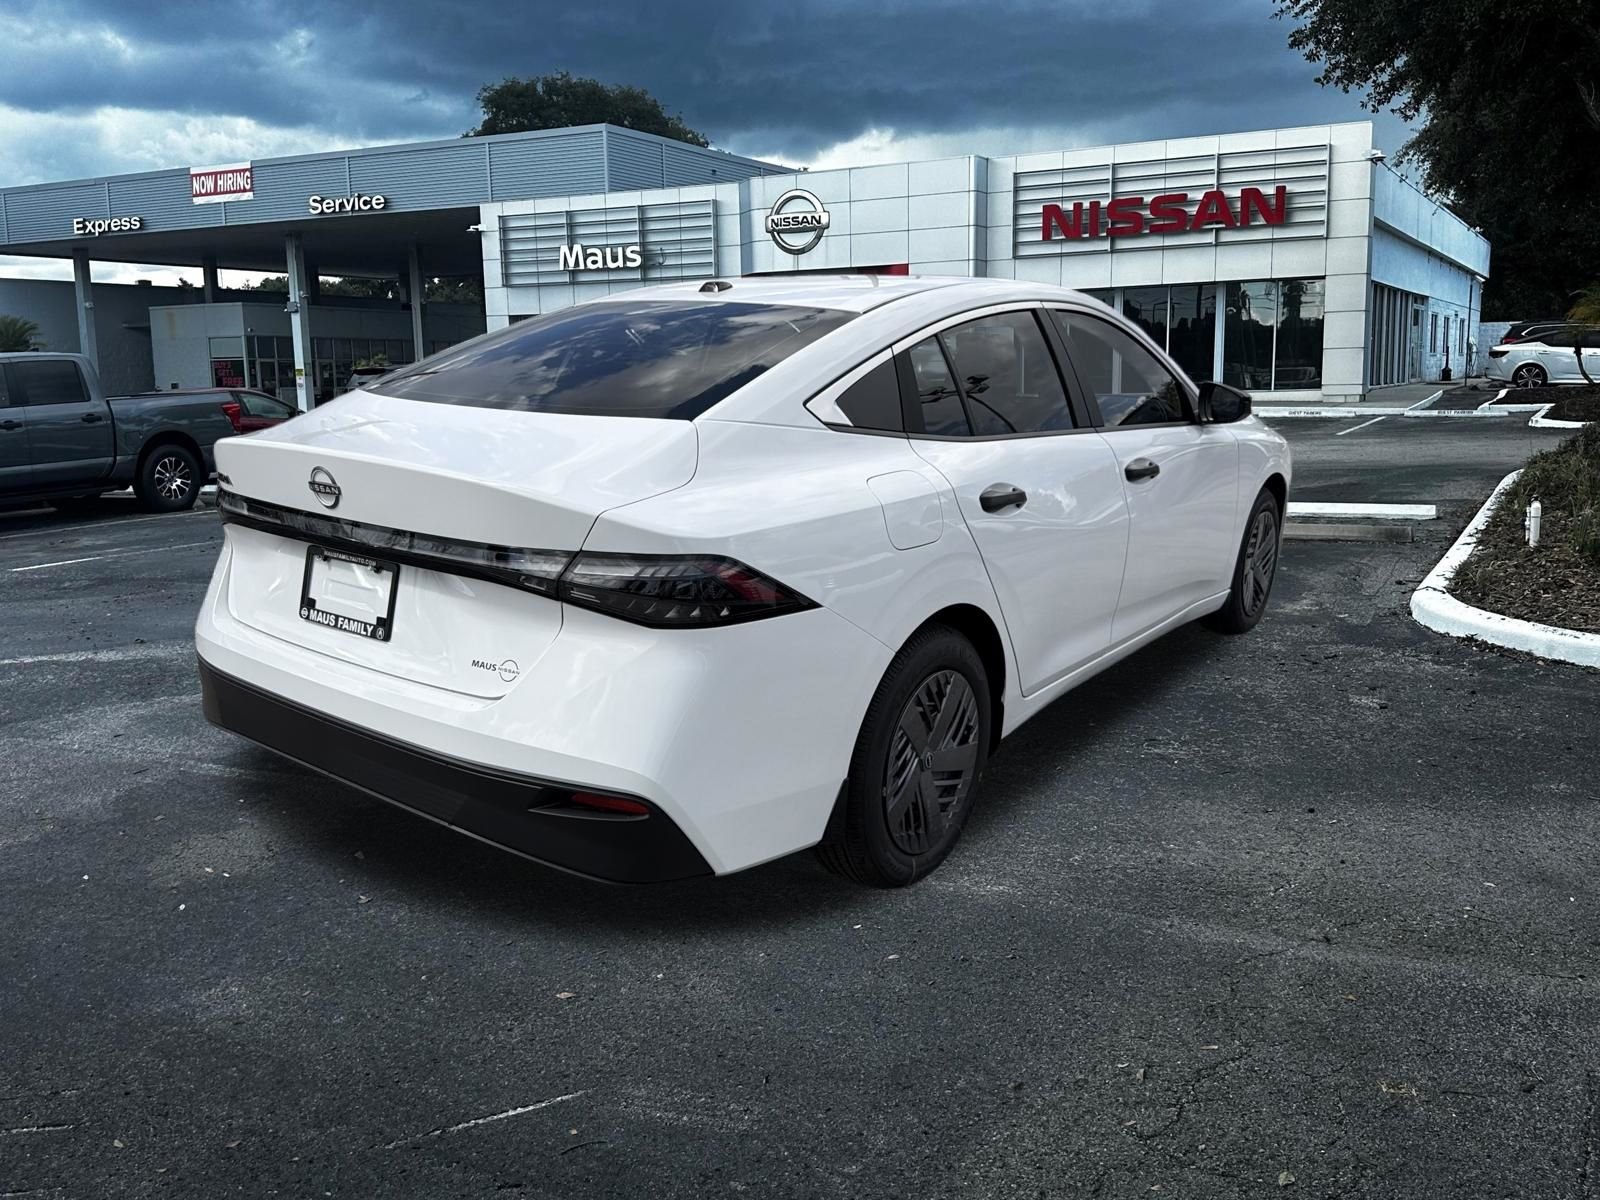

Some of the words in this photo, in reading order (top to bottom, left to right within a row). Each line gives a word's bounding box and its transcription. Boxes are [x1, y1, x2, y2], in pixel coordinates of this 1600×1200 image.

[192, 174, 215, 195] NOW
[217, 171, 251, 192] HIRING
[309, 193, 386, 215] Service
[1041, 184, 1287, 241] NISSAN
[73, 215, 141, 237] Express
[770, 213, 823, 229] NISSAN
[559, 243, 643, 271] Maus
[309, 608, 336, 627] MAUS
[337, 617, 374, 637] FAMILY
[471, 659, 497, 671] MAUS
